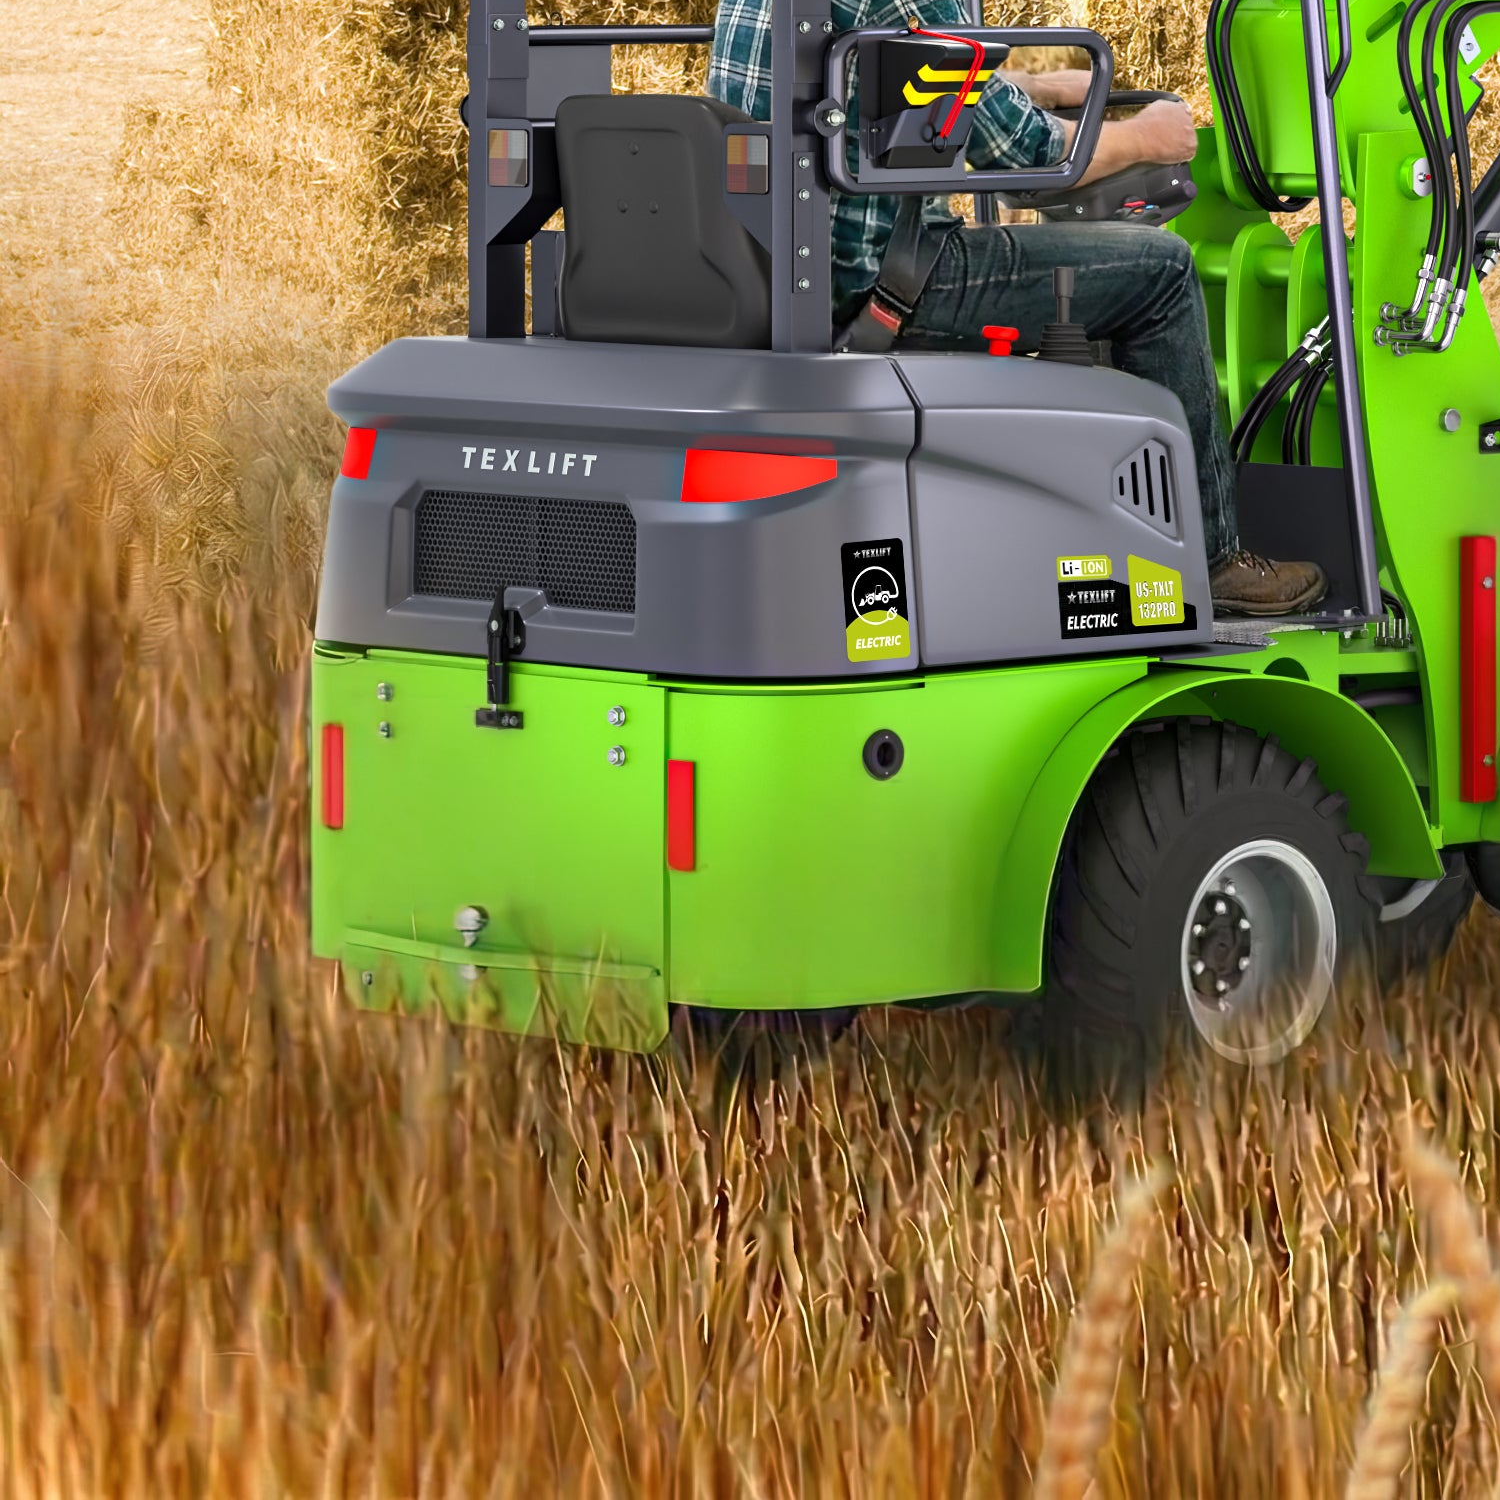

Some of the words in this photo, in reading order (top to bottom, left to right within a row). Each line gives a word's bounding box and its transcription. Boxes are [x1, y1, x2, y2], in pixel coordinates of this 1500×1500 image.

[462, 446, 597, 476] TEXLIFT
[861, 547, 891, 558] TEXLIFT
[1077, 590, 1115, 603] TEXLIFT
[1136, 581, 1174, 598] US-TXLT
[1138, 601, 1176, 619] 132PRO
[1067, 613, 1118, 630] ELECTRIC
[855, 635, 901, 649] ELECTRIC
